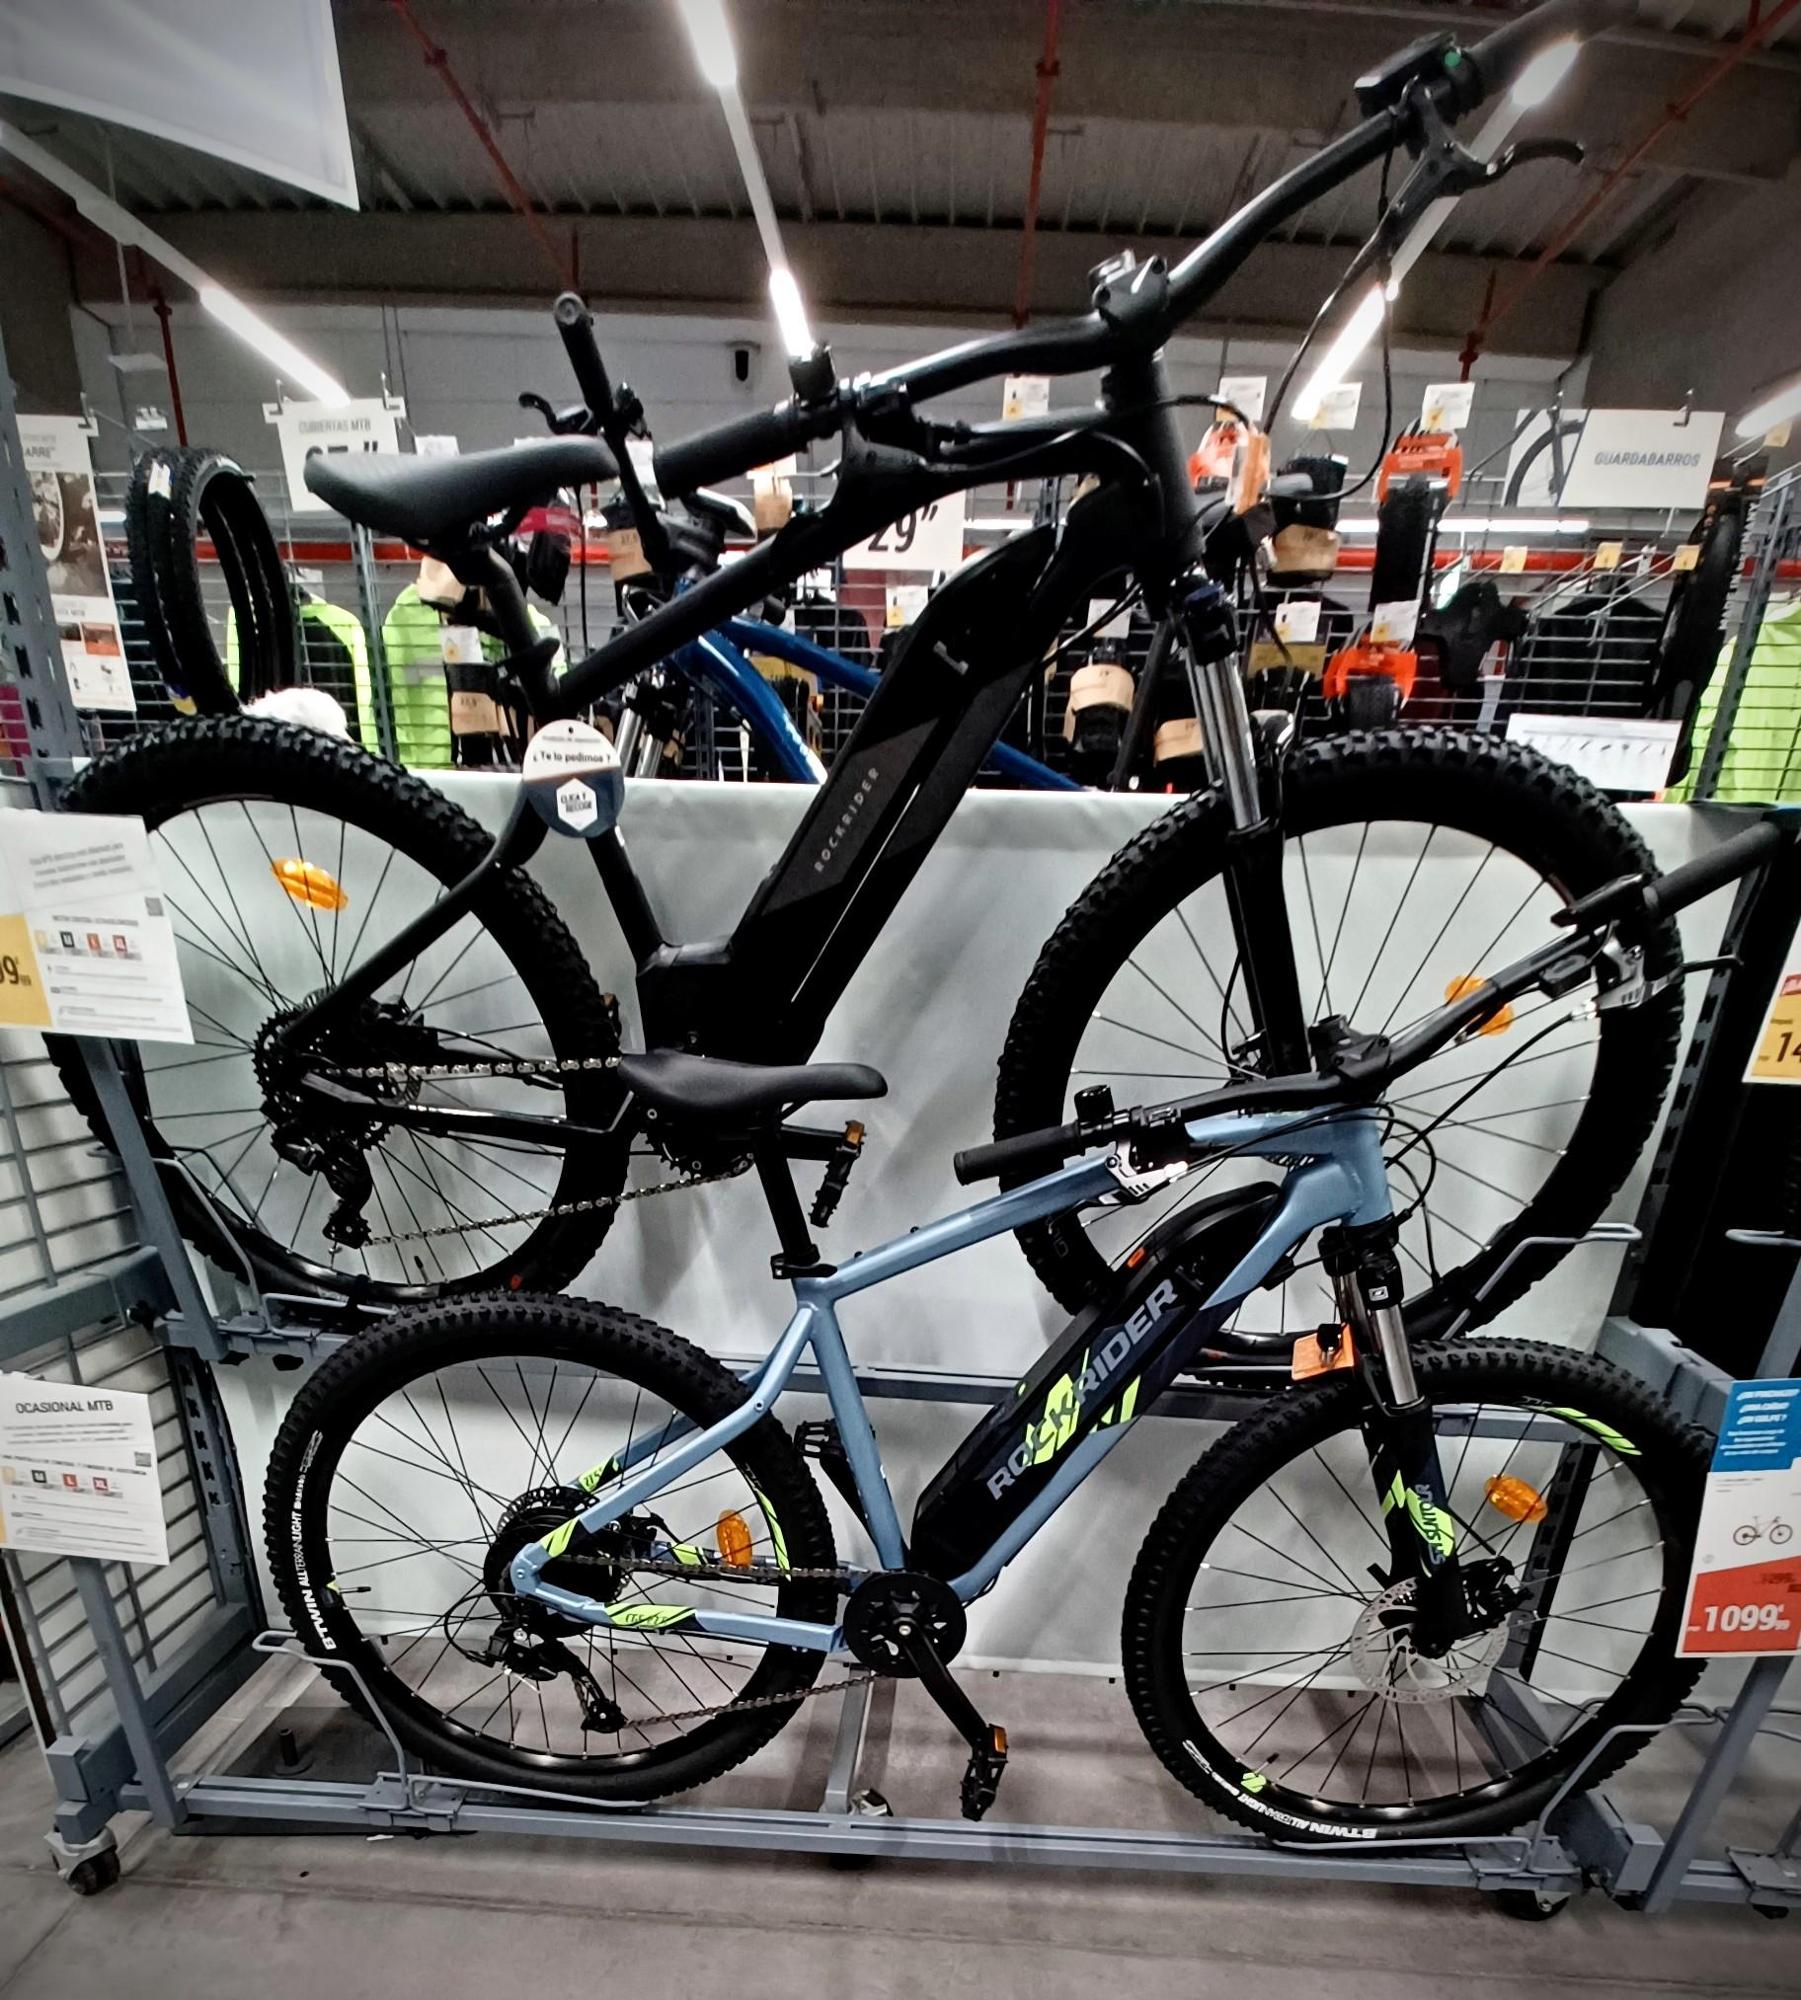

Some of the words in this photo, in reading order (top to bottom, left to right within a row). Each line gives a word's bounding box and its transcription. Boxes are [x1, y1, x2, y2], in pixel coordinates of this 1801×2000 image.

[351, 419, 371, 431] MTB
[1594, 451, 1702, 467] GUARDABARROS
[565, 752, 604, 764] pedimos
[814, 767, 880, 873] ROCKRIDER
[986, 1278, 1179, 1501] ROCKRIDER
[15, 1401, 85, 1414] OCASIONAL
[88, 1400, 113, 1412] MTB
